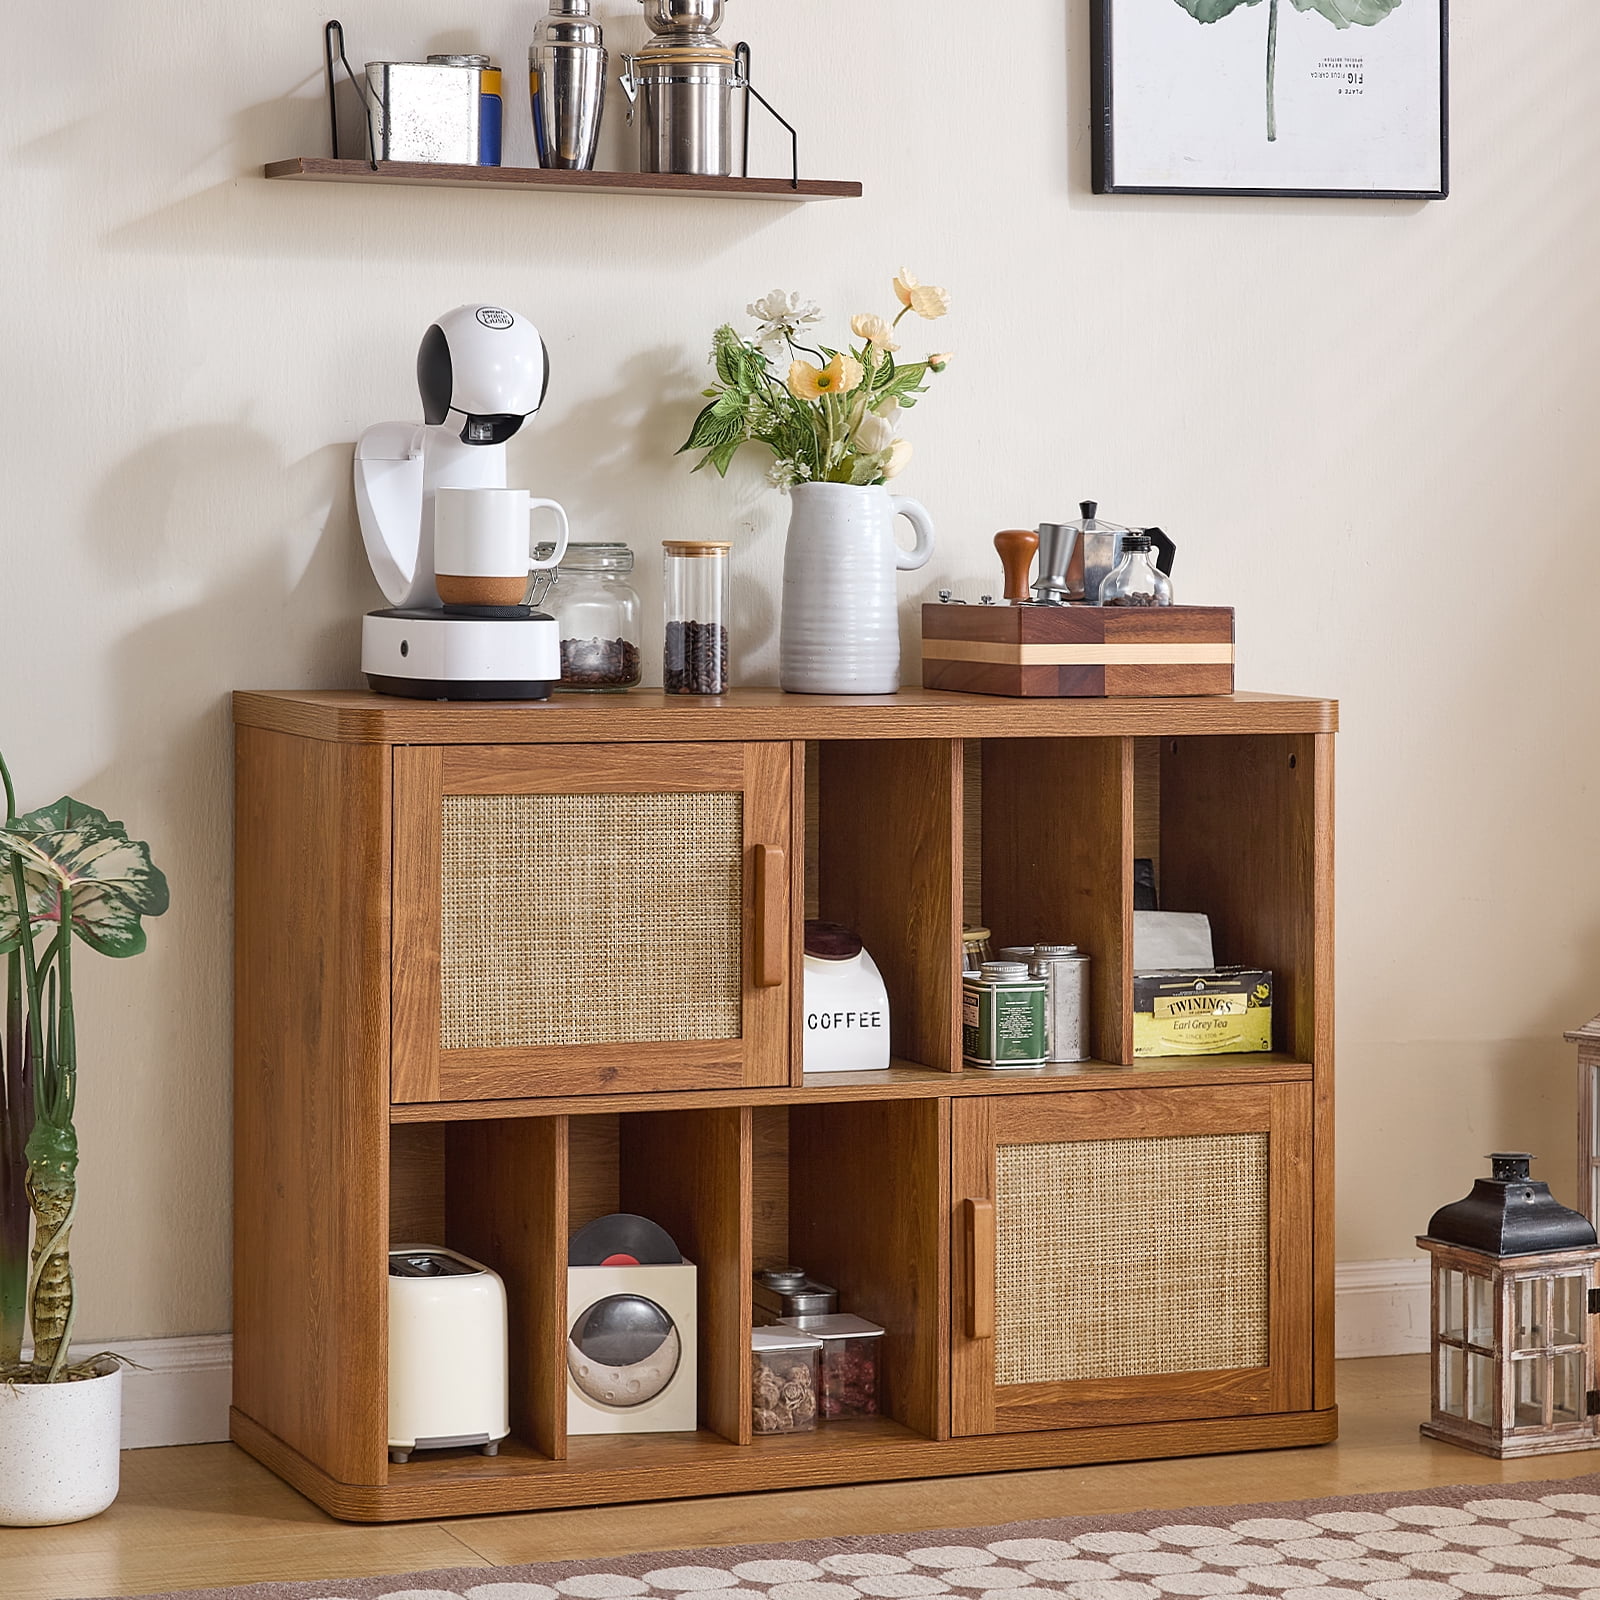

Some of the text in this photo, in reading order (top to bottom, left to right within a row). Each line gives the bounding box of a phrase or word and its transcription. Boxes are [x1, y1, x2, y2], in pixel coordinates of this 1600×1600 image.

[1347, 72, 1363, 84] FIG
[1167, 997, 1232, 1015] TWININGS
[807, 1012, 881, 1030] COFFEE
[1173, 1019, 1228, 1031] Earl Grey Tea
